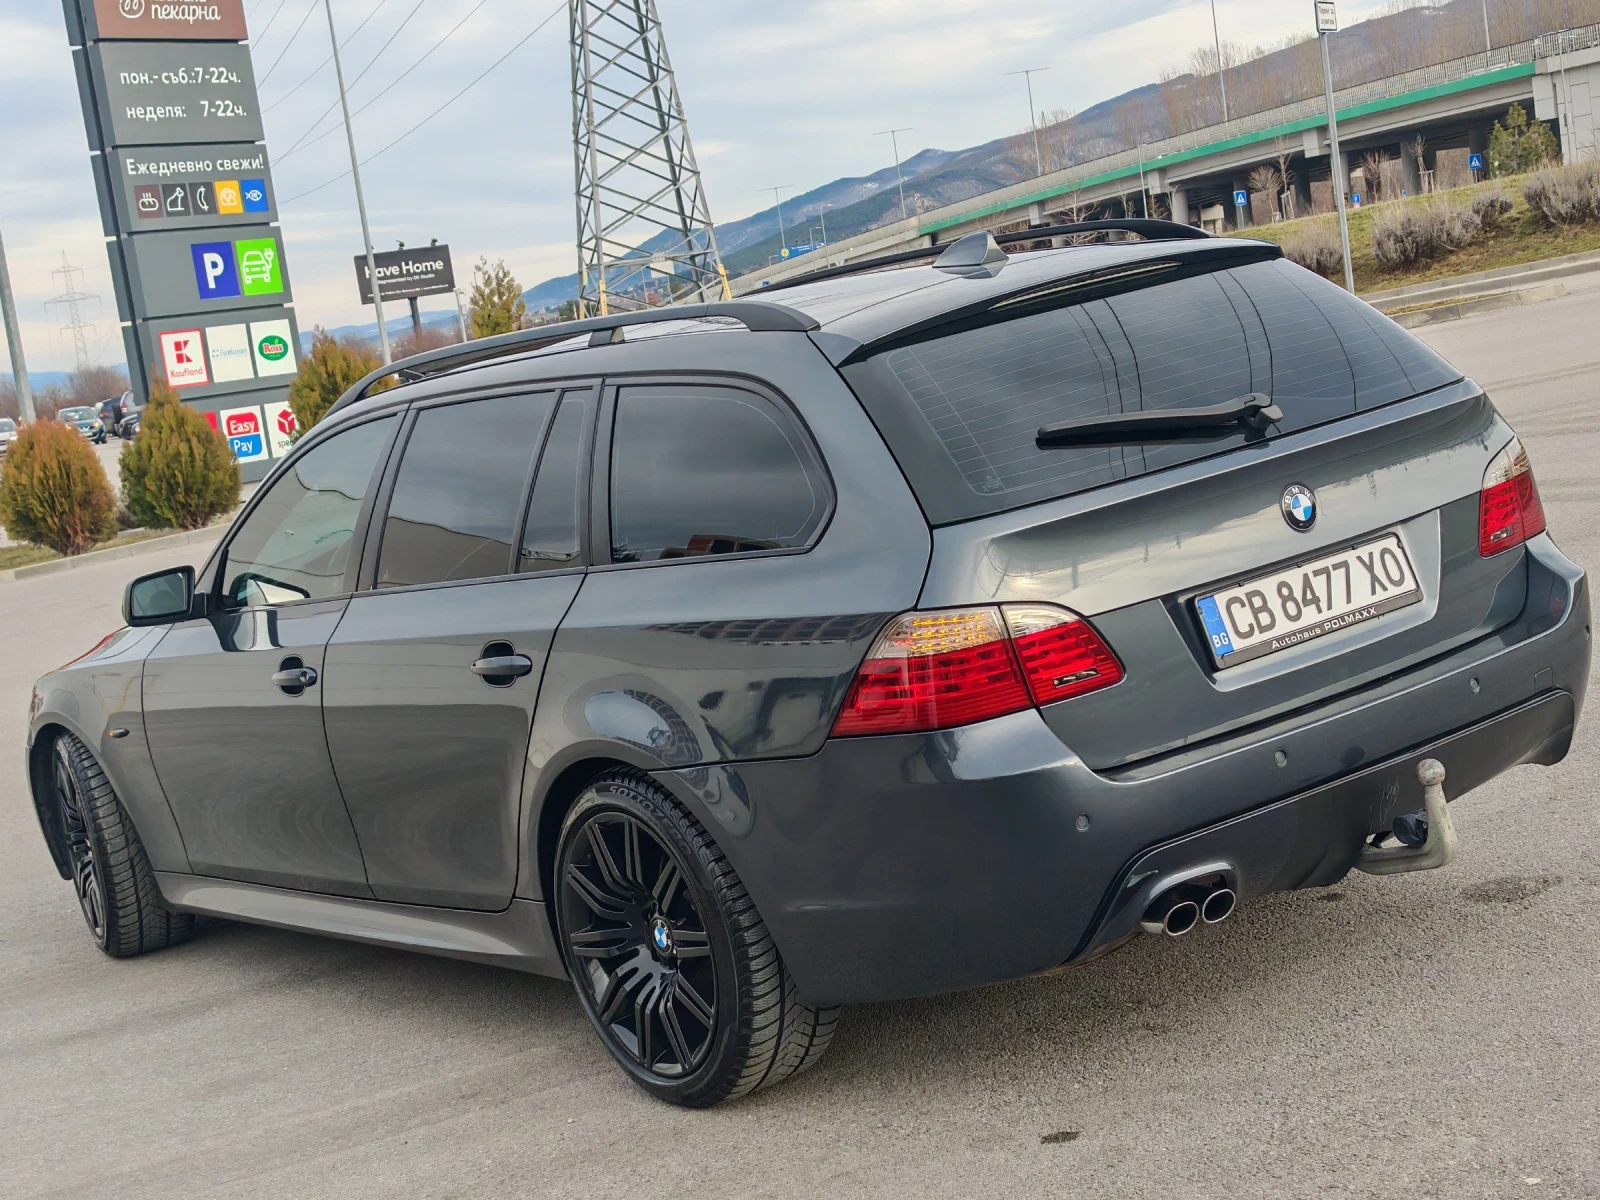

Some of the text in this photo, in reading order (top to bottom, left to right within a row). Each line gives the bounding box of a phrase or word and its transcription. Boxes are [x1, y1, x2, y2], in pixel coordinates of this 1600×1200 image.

[151, 3, 221, 24] пекарна
[126, 100, 247, 121] неделя: 7-22ч.
[126, 154, 265, 176] Ежедневно свежи!
[203, 252, 224, 289] P
[401, 260, 444, 275] Home
[170, 367, 204, 378] Kaufland
[230, 420, 255, 434] Easy
[234, 440, 253, 454] Pay
[1276, 559, 1352, 623] 8477
[1271, 606, 1377, 650] Autohaus POLMAXX
[1211, 633, 1229, 648] BG
